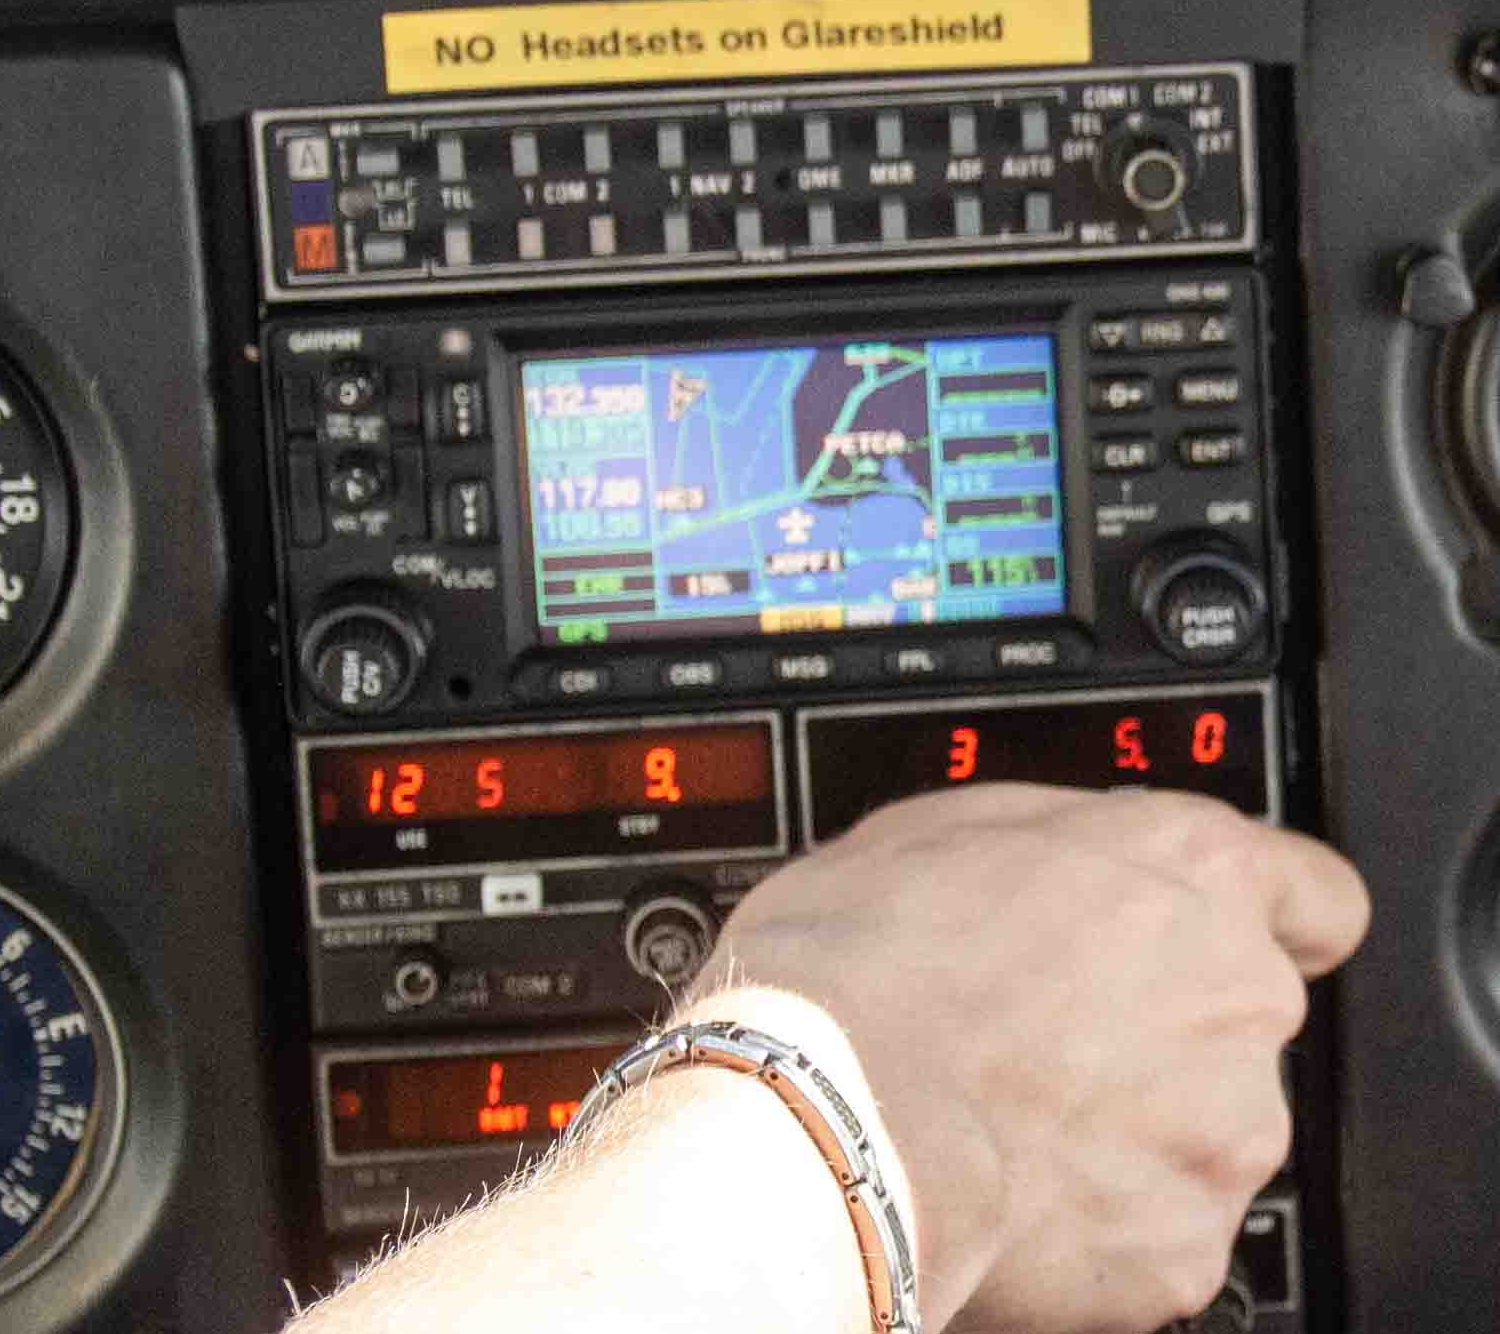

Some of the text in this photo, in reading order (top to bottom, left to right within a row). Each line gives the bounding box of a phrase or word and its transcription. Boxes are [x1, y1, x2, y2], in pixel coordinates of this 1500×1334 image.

[435, 14, 1005, 66] NO Headsets on Glareshield
[0, 927, 34, 964] 6
[47, 1010, 88, 1046] E
[50, 1102, 89, 1143] 12
